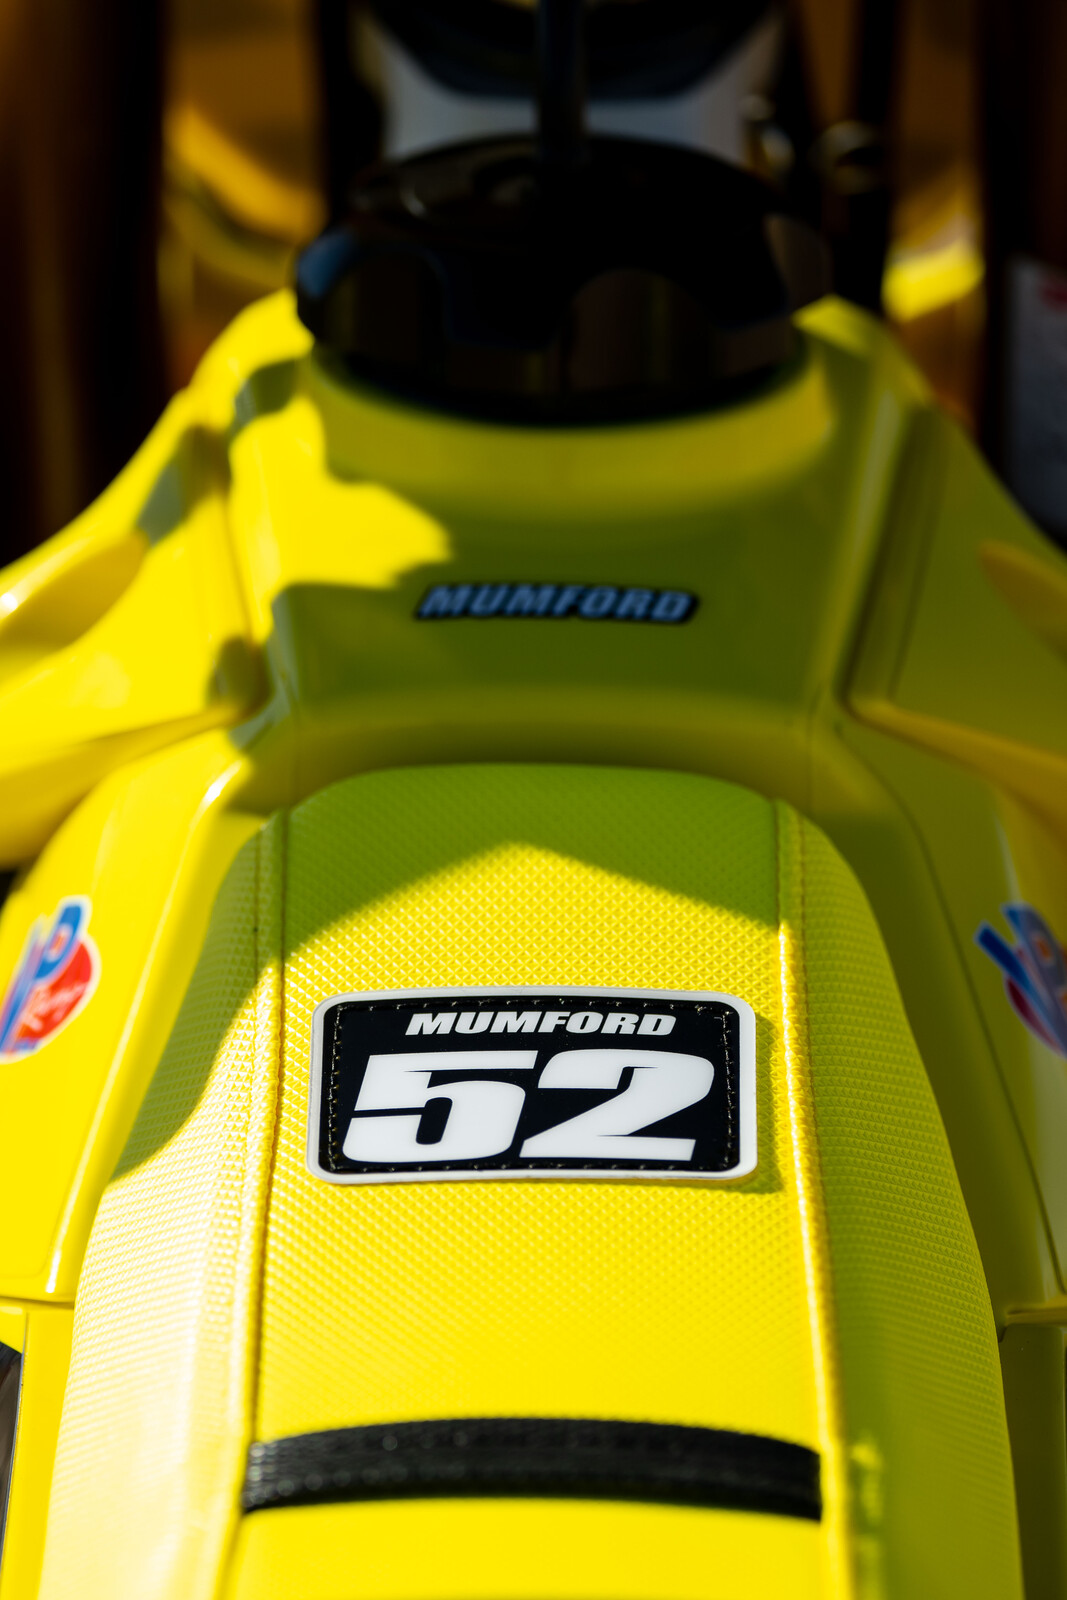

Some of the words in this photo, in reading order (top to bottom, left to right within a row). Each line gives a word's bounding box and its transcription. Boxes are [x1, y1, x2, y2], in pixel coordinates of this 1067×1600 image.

[419, 584, 693, 621] MUMFORD
[405, 1011, 677, 1036] MUMFORD
[342, 1048, 715, 1163] 52
